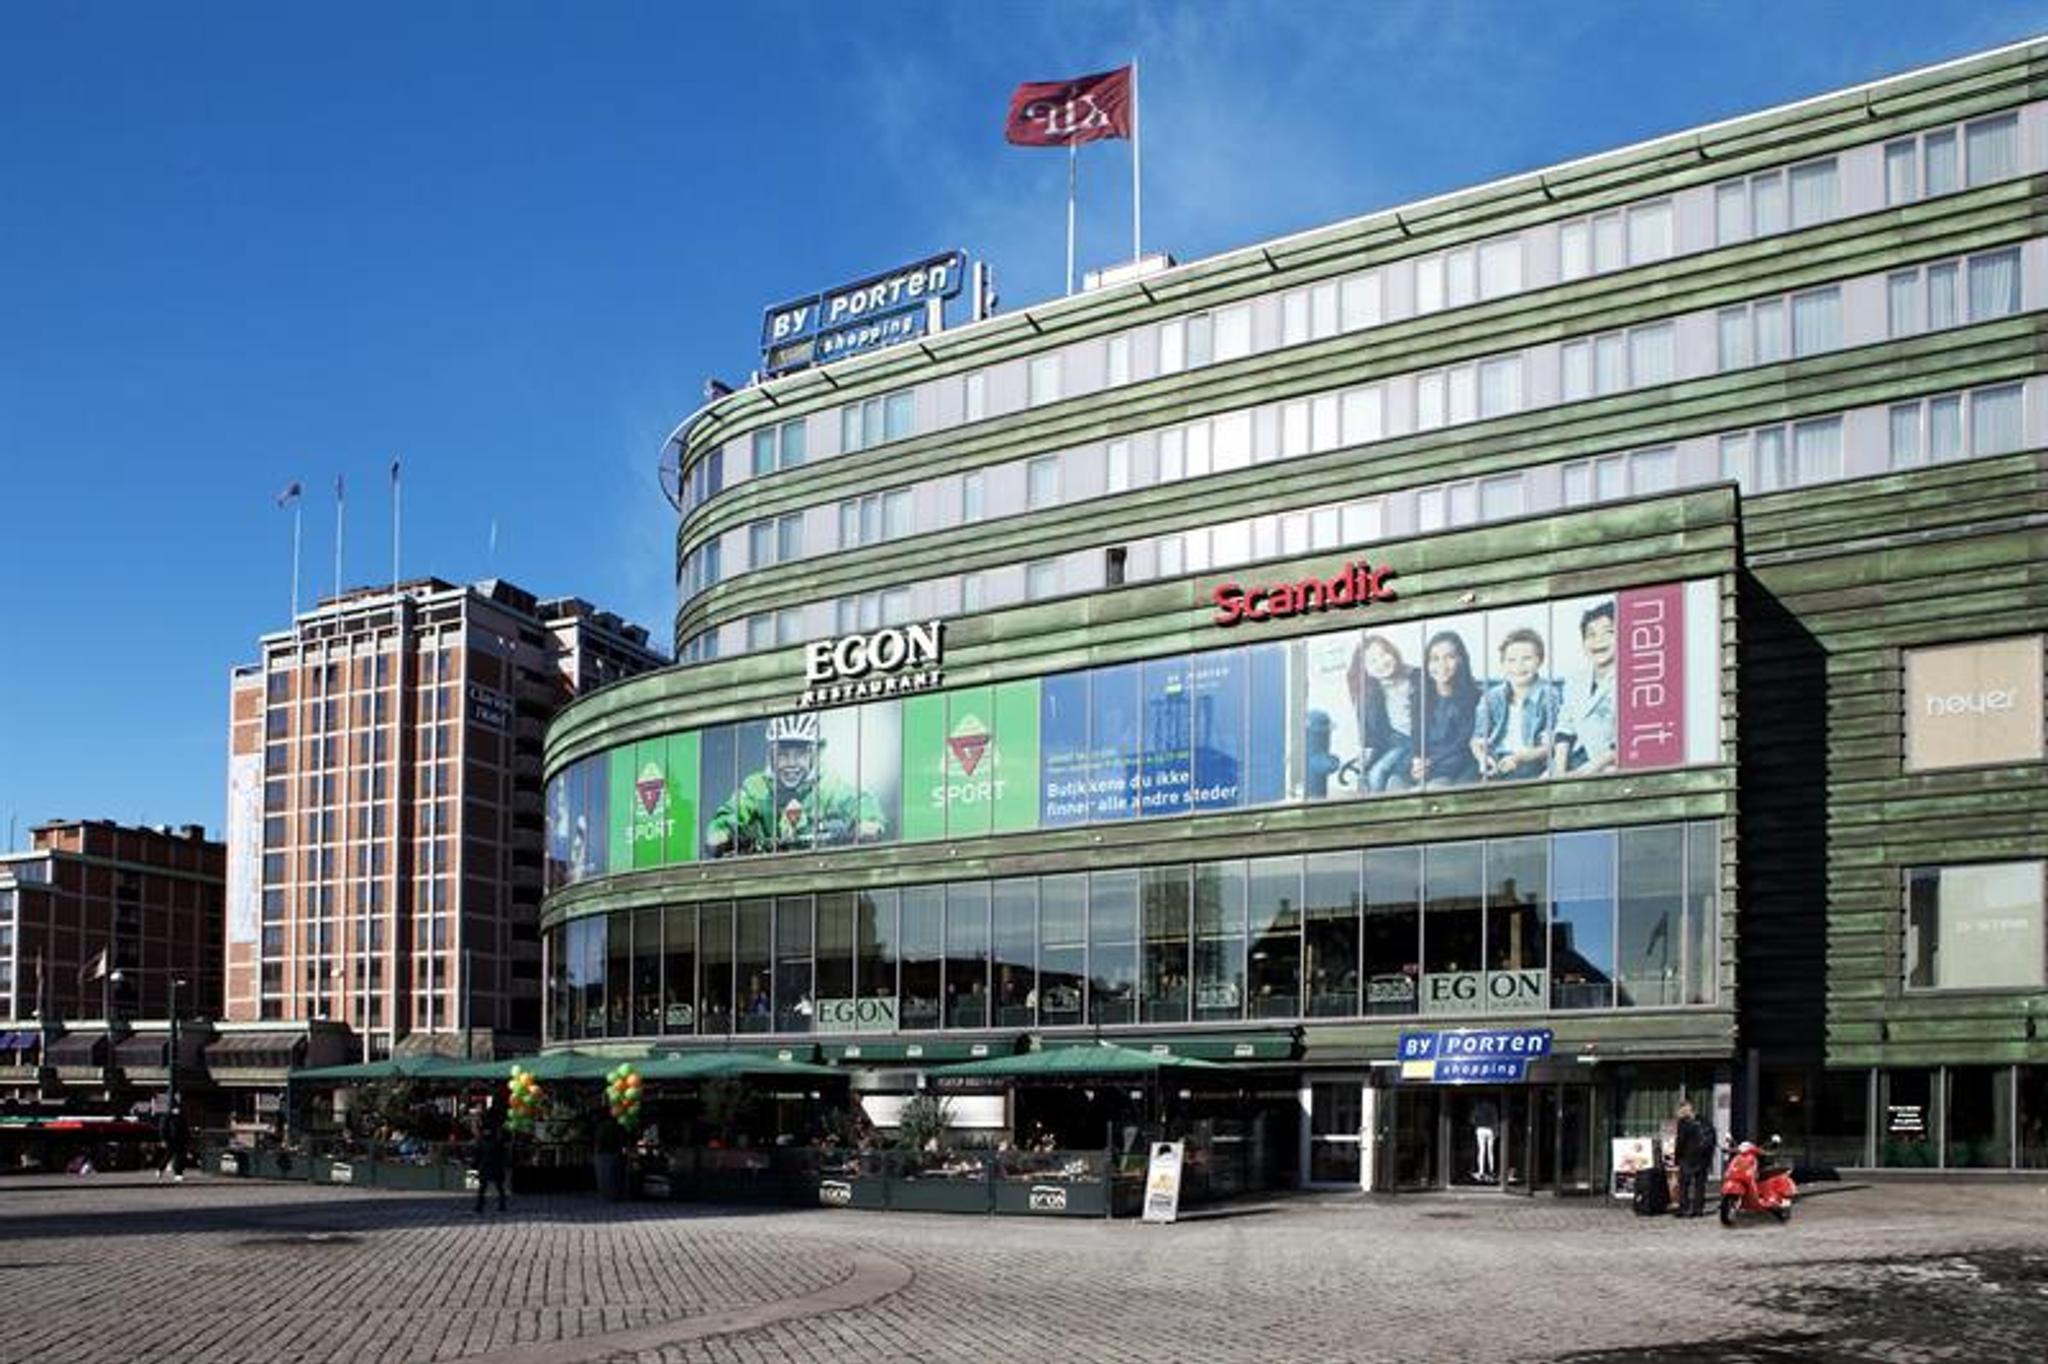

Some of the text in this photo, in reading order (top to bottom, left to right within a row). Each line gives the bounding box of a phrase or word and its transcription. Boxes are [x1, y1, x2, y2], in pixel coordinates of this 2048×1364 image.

[772, 308, 808, 340] BY
[823, 314, 914, 354] shopping
[1212, 560, 1394, 625] Scandic
[805, 620, 941, 680] EGON
[1631, 598, 1665, 709] name
[930, 780, 1005, 808] SPORT
[622, 818, 677, 845] SPORT
[818, 1000, 895, 1024] EGON
[1404, 1038, 1431, 1056] BY
[1442, 1061, 1518, 1077] shopping
